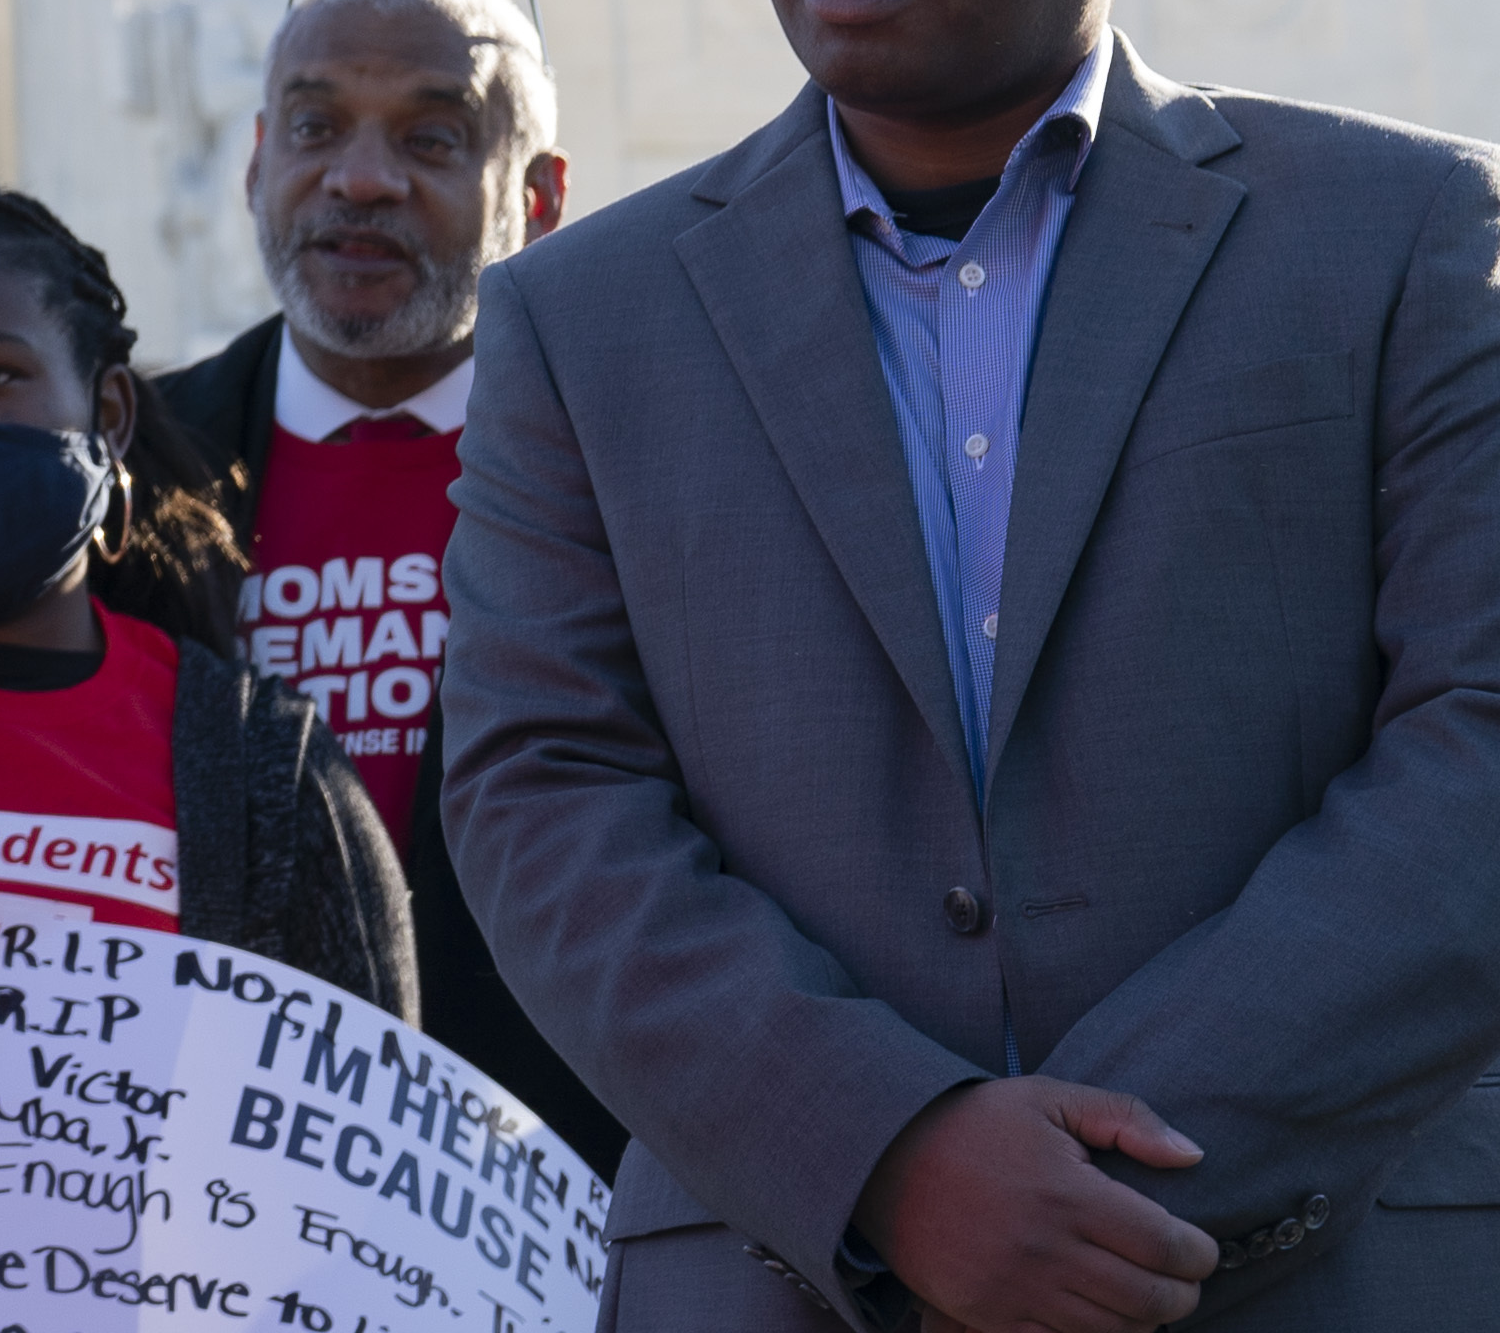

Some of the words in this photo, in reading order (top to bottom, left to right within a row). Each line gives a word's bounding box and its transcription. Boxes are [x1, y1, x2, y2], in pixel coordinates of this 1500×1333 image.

[236, 609, 450, 678] EMAN
[335, 727, 400, 756] NSE
[30, 1046, 187, 1120] Victor
[257, 1012, 372, 1107] I'M
[388, 1071, 550, 1231] HERE
[205, 1179, 258, 1229] is
[230, 1085, 550, 1304] BECAUSE
[31, 1246, 251, 1318] Deserve
[268, 1291, 333, 1333] to
